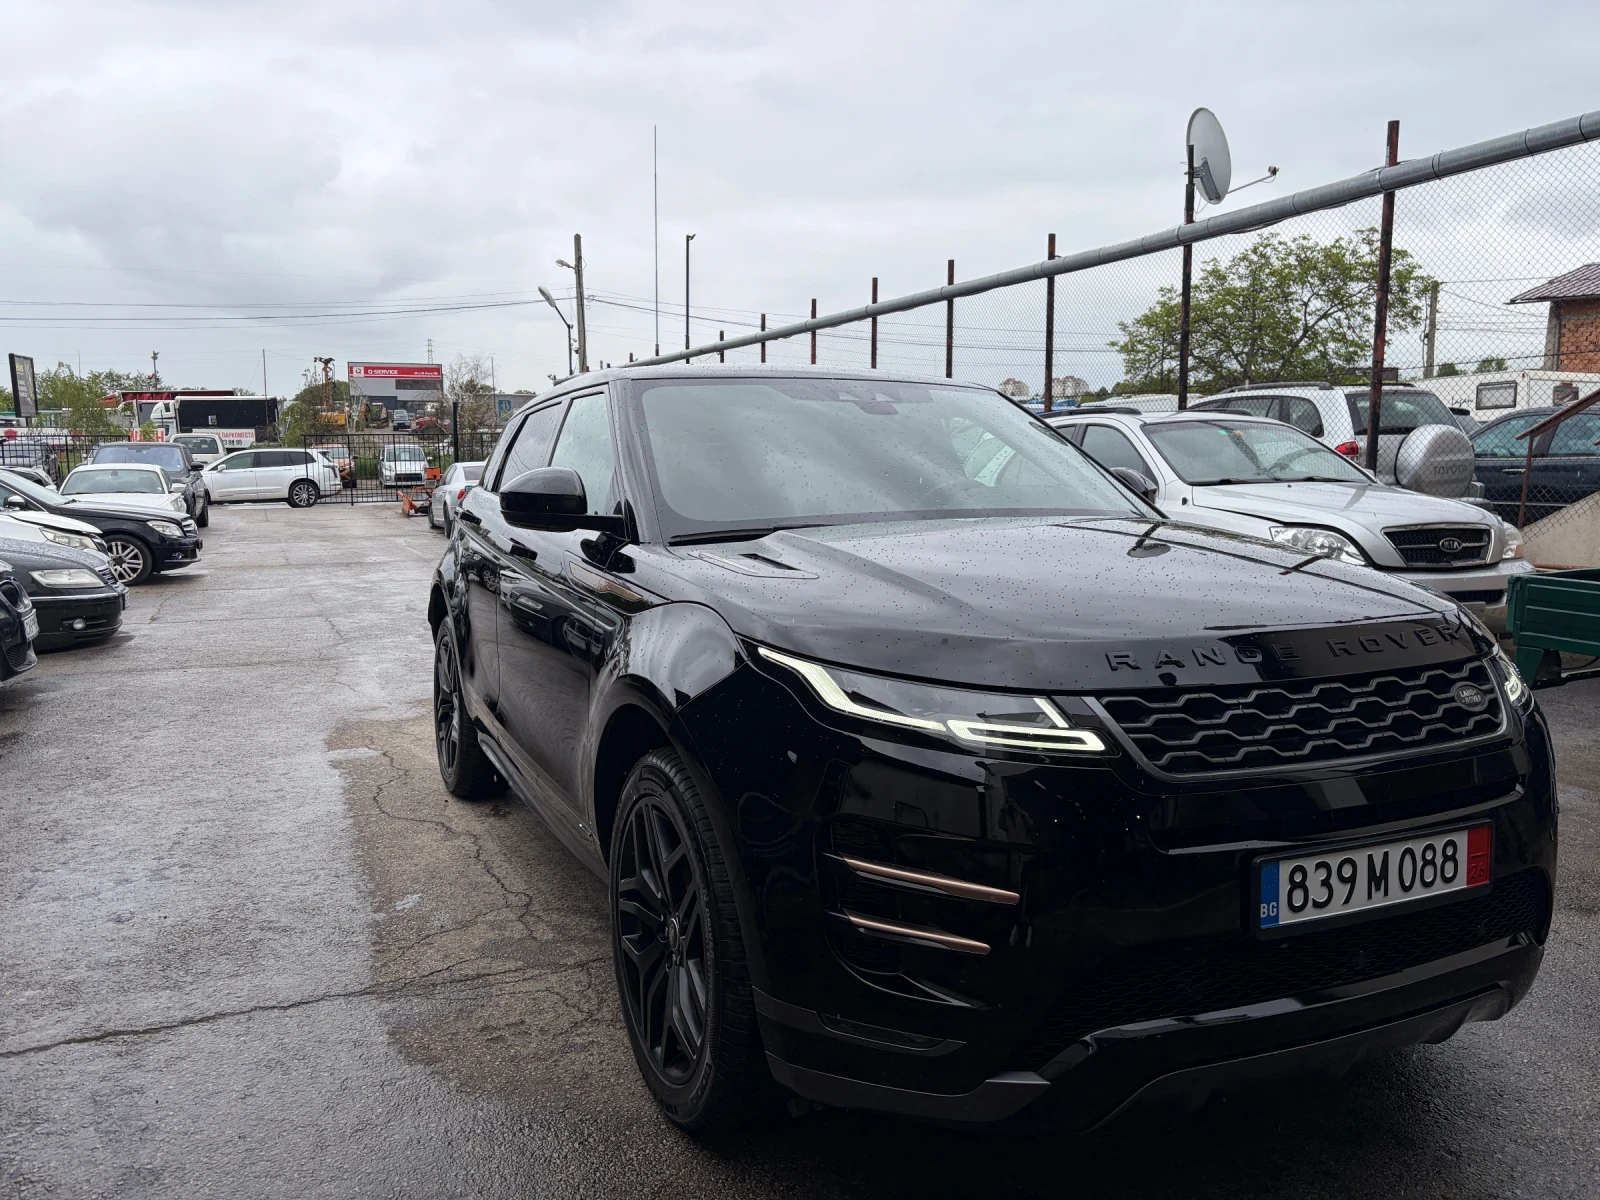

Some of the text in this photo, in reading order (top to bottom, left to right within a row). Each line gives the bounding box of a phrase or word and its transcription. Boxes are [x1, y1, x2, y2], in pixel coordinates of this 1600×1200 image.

[1433, 464, 1468, 475] TOYOTA
[1443, 540, 1460, 549] KIA
[1104, 622, 1464, 672] RANGE ROVER
[1260, 901, 1278, 918] BG
